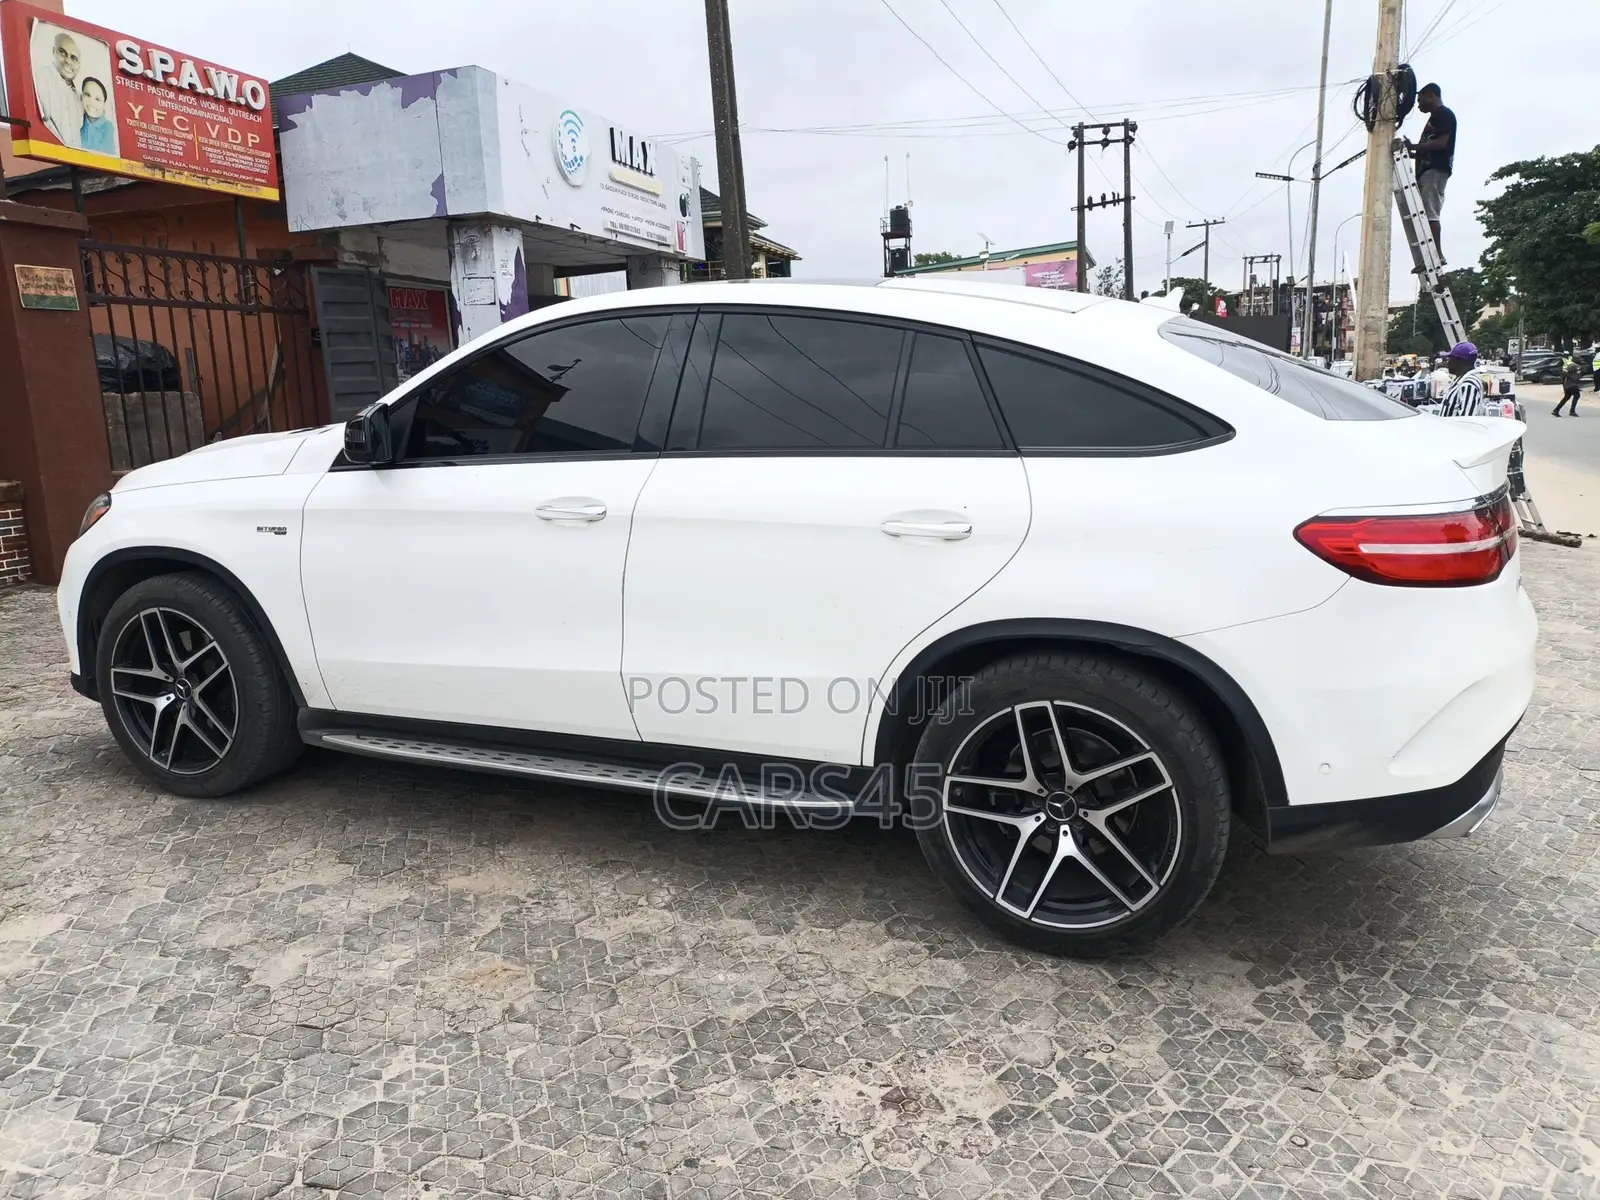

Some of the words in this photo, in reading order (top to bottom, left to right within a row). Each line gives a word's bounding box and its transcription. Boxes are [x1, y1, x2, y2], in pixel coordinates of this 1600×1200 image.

[115, 39, 266, 111] S.P.A.W.O
[115, 75, 144, 91] STREET
[147, 84, 176, 100] PASTOR
[178, 93, 197, 106] AYO'S
[200, 99, 225, 113] WORLD
[228, 107, 263, 124] OUTREACH
[389, 287, 429, 311] MAX
